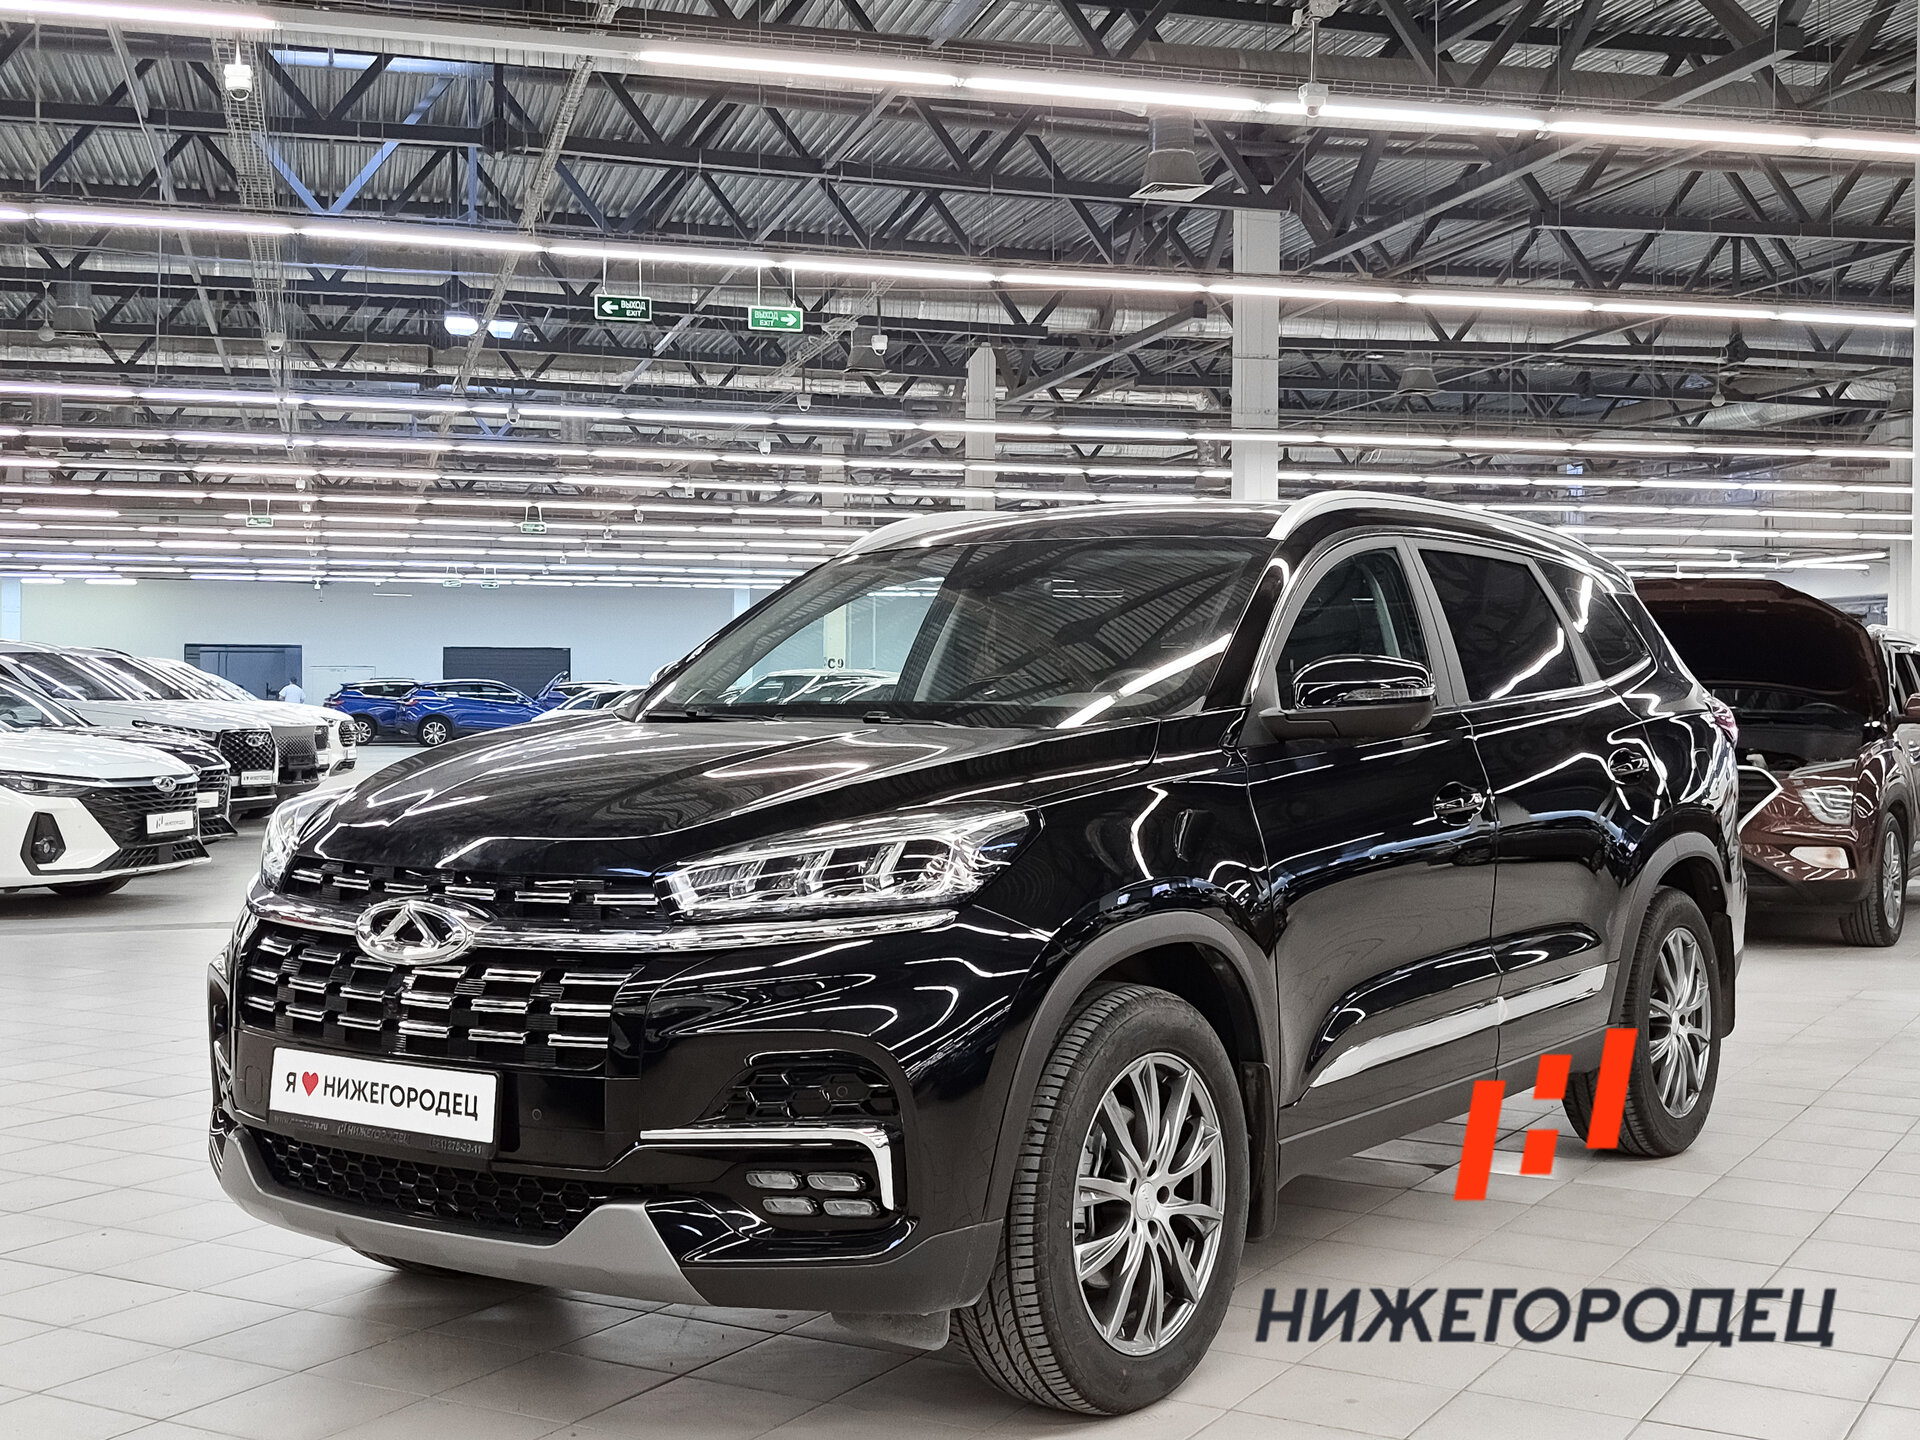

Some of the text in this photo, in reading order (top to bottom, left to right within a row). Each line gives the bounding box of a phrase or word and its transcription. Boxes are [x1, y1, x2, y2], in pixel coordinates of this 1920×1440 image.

[620, 300, 646, 310] ВЫХОД
[754, 310, 779, 320] ВЫХОД
[285, 1071, 479, 1121] Я НИЖЕГОРОДЕЦ
